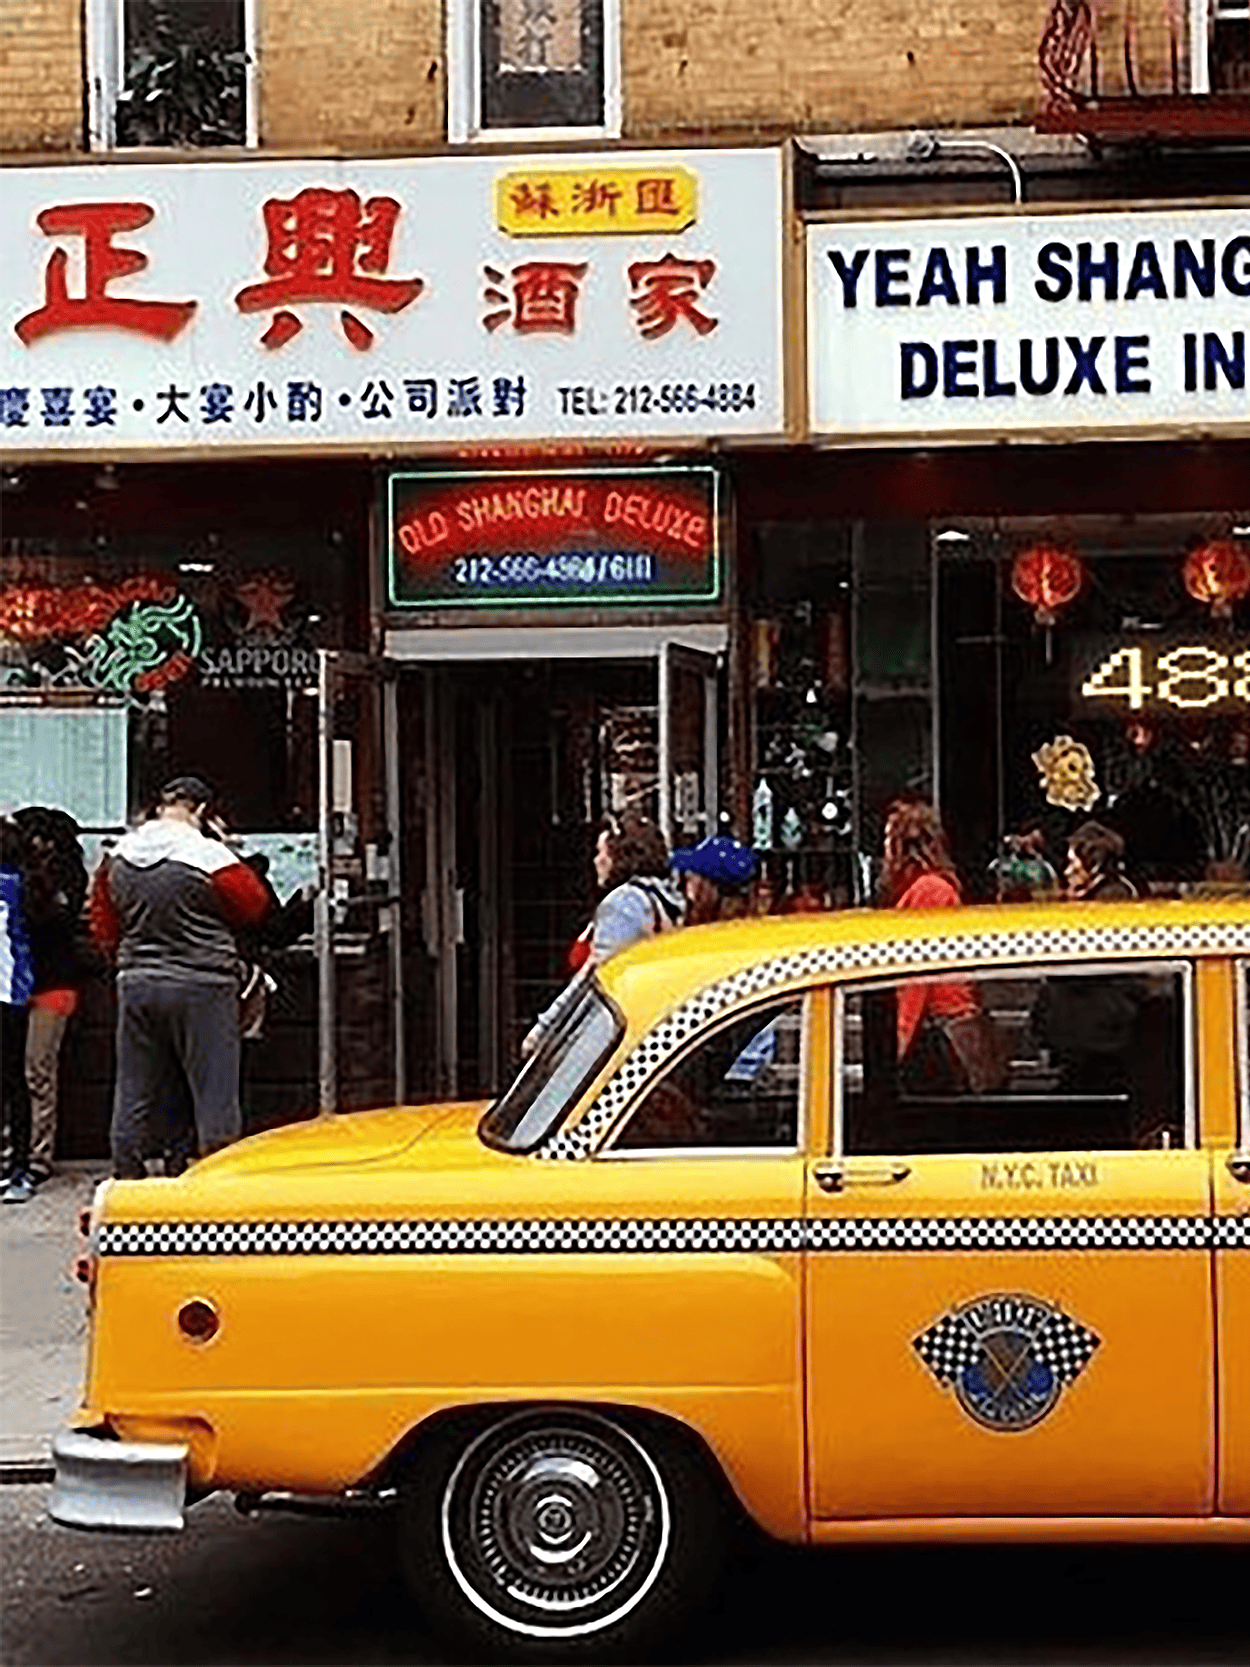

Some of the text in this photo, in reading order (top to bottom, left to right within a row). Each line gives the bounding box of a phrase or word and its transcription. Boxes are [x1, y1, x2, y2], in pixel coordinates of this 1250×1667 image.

[14, 187, 719, 353] 正興 酒家
[827, 245, 1007, 308] YEAH
[900, 334, 1152, 400] DELUXE
[557, 385, 608, 415] TEL:
[399, 511, 448, 554] OLD
[1048, 1160, 1100, 1189] TAXI
